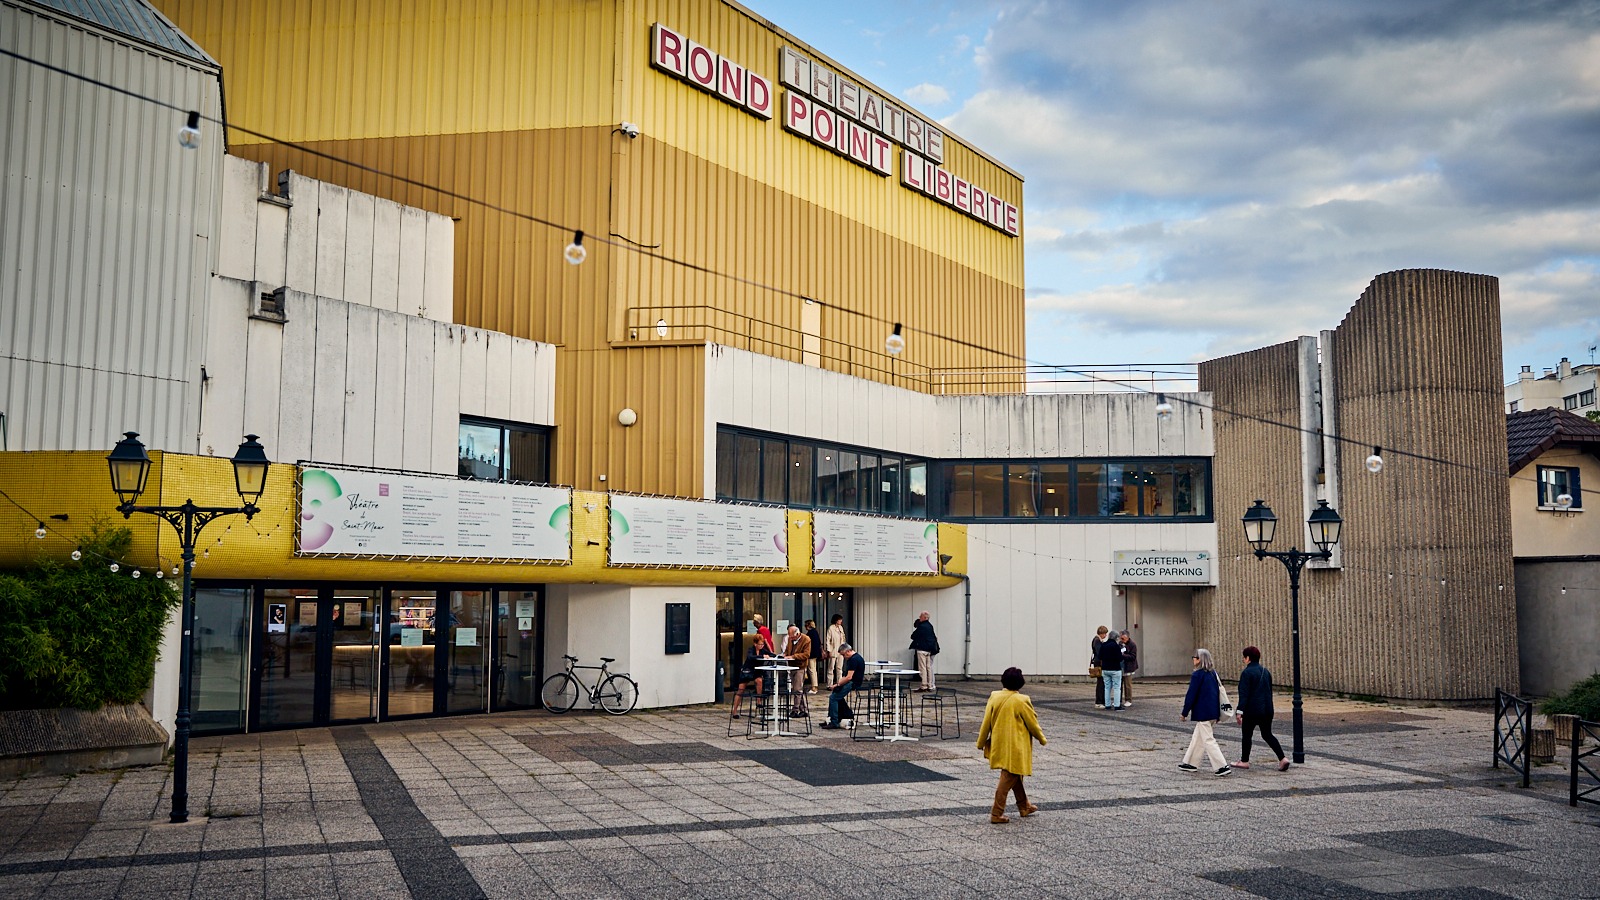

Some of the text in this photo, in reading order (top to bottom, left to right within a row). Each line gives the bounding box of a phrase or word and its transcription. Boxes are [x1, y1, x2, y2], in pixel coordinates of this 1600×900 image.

[787, 48, 942, 162] THEATRE
[659, 28, 1018, 233] ROND POINT LIBERTE
[346, 493, 379, 510] Théâtre
[341, 519, 385, 532] Saint-Maur
[1134, 557, 1188, 565] CAFETERIA
[1121, 568, 1203, 576] ACCES PARKING
